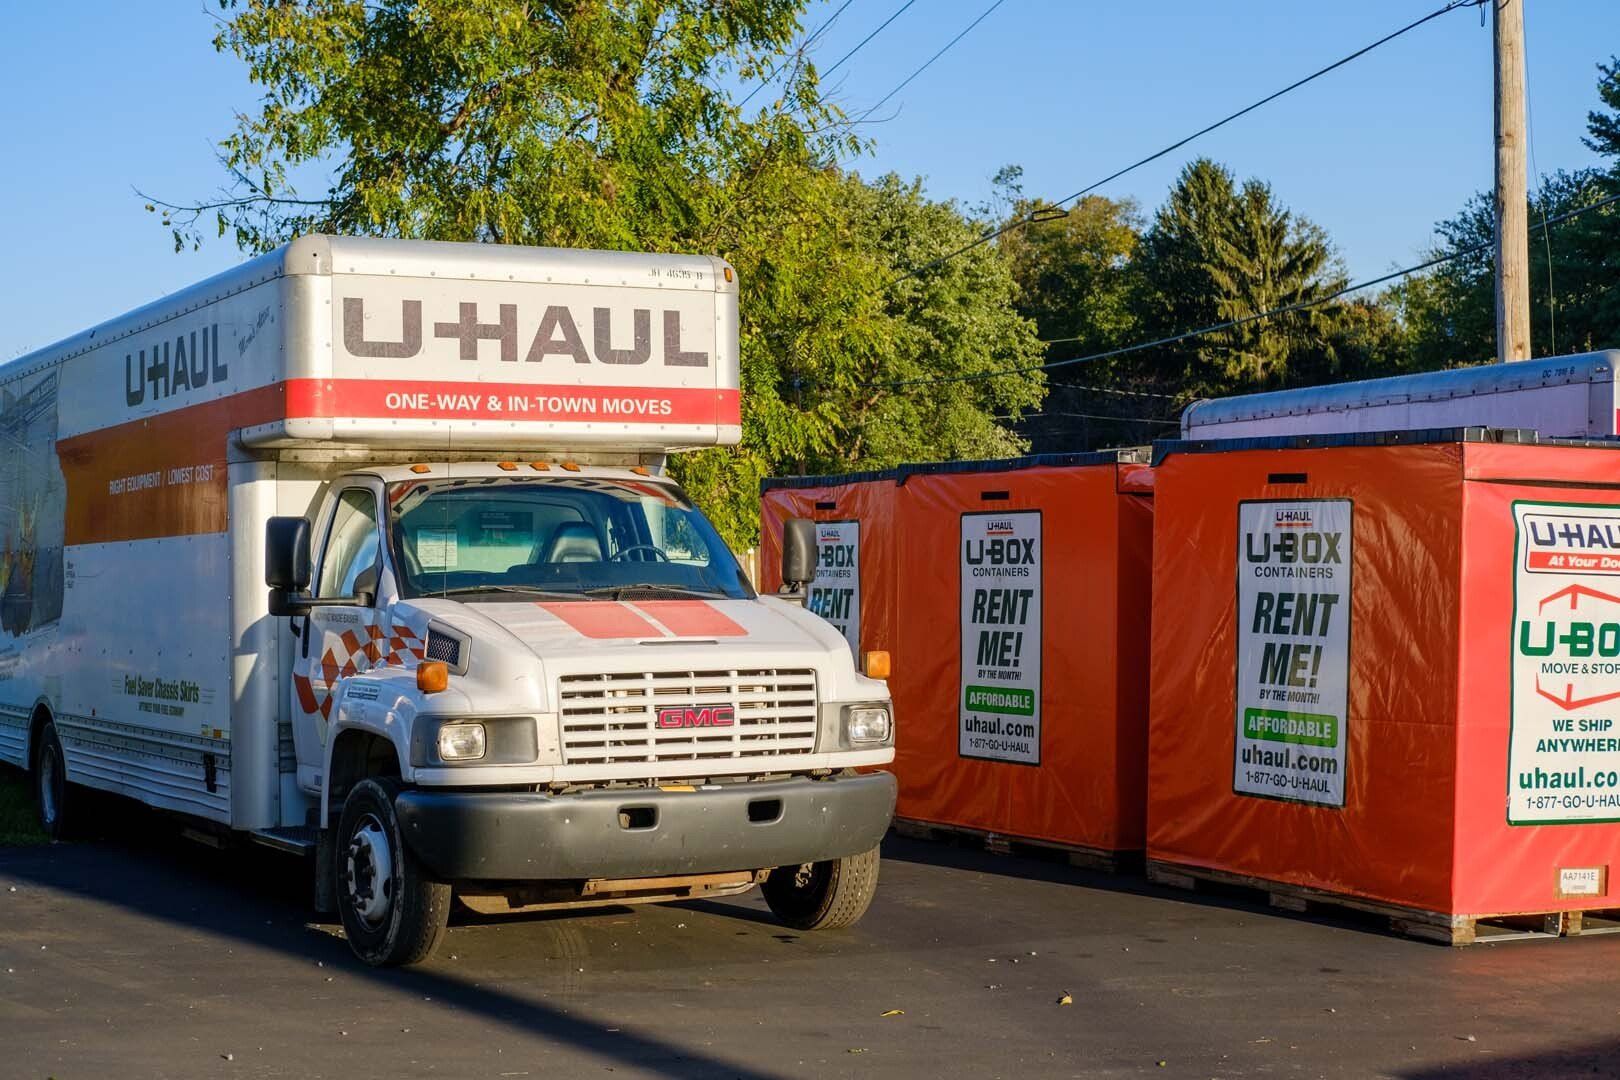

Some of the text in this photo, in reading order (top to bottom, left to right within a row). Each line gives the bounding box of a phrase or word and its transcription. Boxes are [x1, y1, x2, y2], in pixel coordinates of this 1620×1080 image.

[342, 296, 710, 368] U-HAUL
[126, 323, 228, 407] U-HAUL
[385, 393, 673, 415] ONE-WAY & IN-TOWN MOVES
[109, 478, 126, 496] RIGHT
[127, 471, 161, 492] EQUIPMENT
[168, 466, 194, 485] LOWEST
[195, 464, 214, 482] COST
[987, 521, 1014, 531] U-HAUL
[1276, 511, 1312, 522] U-HAUL
[1530, 521, 1620, 549] U-HAU
[966, 538, 1035, 565] U-BOX
[1246, 532, 1342, 564] U-BOX
[816, 569, 851, 578] ONTAINERS
[972, 567, 1029, 577] CONTAINERS
[1254, 566, 1333, 579] CONTAINERS
[1549, 555, 1620, 569] At Your Do
[810, 588, 854, 620] RENT
[971, 588, 1034, 625] RENT
[1252, 591, 1340, 637] RENT
[976, 630, 1023, 667] ME!
[1520, 620, 1620, 658] U-BO
[978, 669, 1022, 681] BY THE MONTH!
[1259, 642, 1323, 688] ME!
[1541, 662, 1620, 675] MOVE & STOR
[124, 674, 200, 704] Fuel Saver Chassis Skirts
[969, 691, 1031, 709] AFFORDABLE
[1259, 688, 1321, 705] BY THE MONTH!
[660, 706, 734, 728] GMC
[965, 715, 1035, 738] uhaul.com
[1248, 715, 1332, 739] AFFORDABLE
[1552, 719, 1613, 731] WE SHIP
[968, 738, 1031, 754] 1-877-GO-U-HAUL
[1536, 738, 1620, 752] ANYWHER
[1242, 744, 1338, 775] uhaul.com
[1246, 770, 1331, 793] 1-877-GO-U-HAUL
[1519, 766, 1620, 789] uhaul.co
[1527, 794, 1620, 809] 1-877-GO-U-HA
